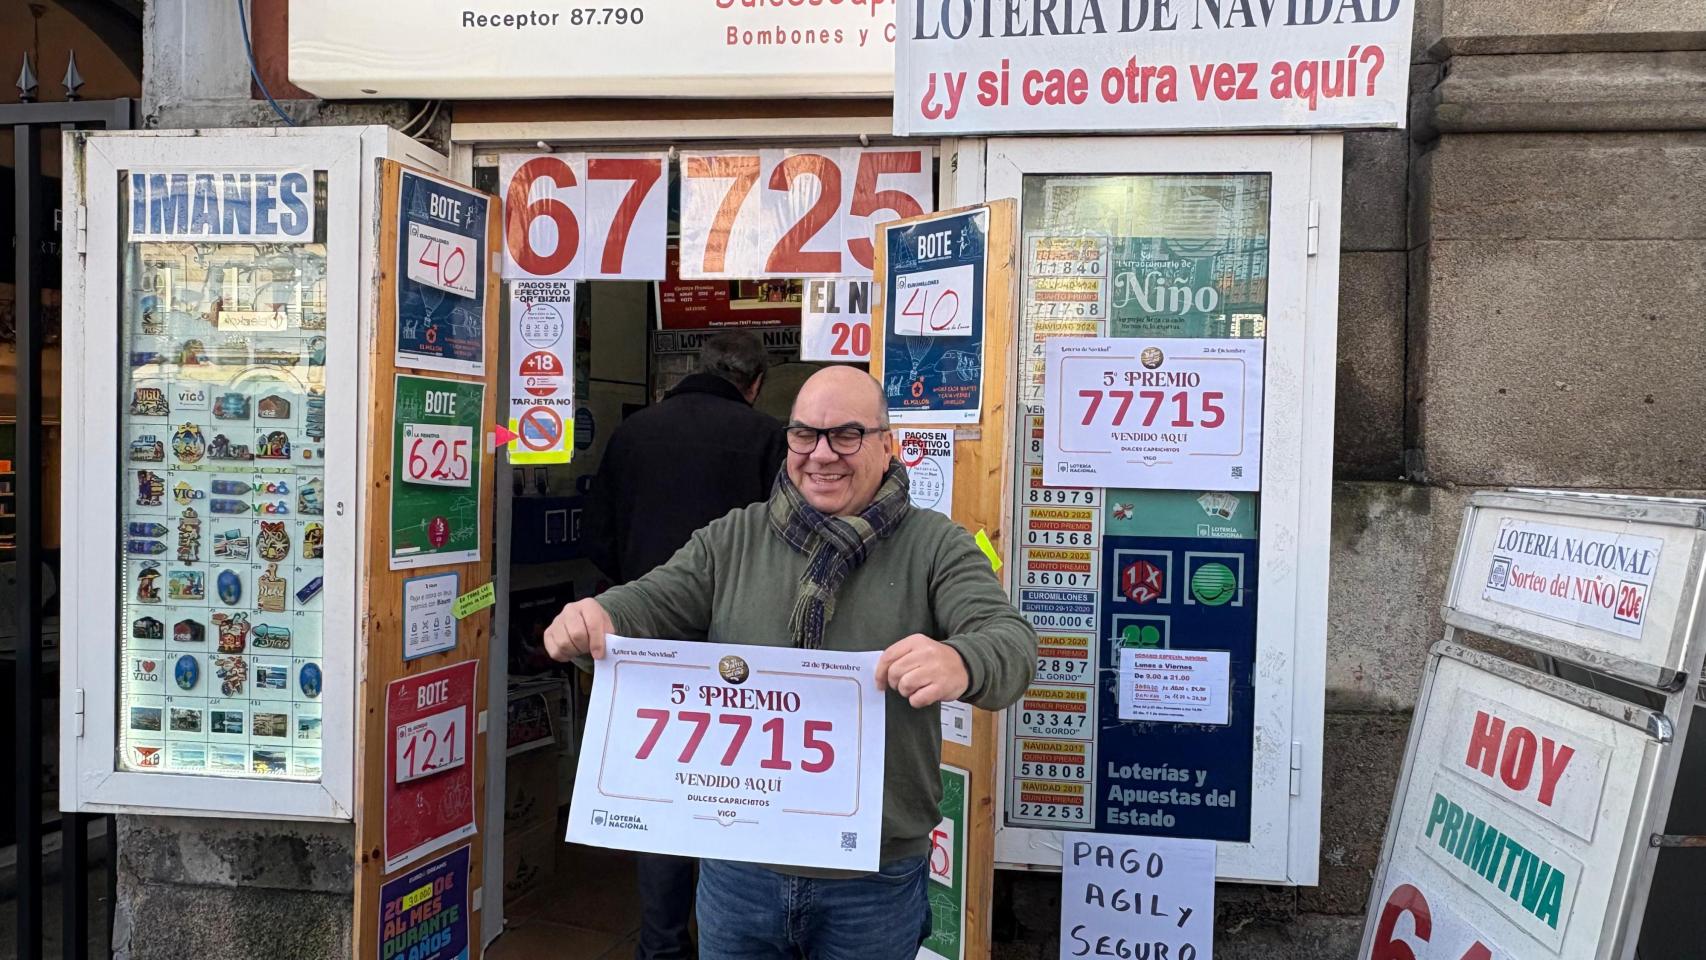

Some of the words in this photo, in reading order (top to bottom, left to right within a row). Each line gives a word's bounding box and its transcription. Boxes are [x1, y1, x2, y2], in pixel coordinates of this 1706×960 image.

[462, 11, 559, 29] Receptor
[570, 8, 645, 26] 87.790
[1108, 0, 1178, 33] DE
[726, 26, 843, 45] Bombones
[859, 28, 868, 47] y
[921, 71, 967, 120] ¿y
[977, 58, 1010, 106] si
[1022, 64, 1088, 106] cae
[1101, 54, 1177, 104] otra
[1190, 62, 1258, 102] vez
[1270, 45, 1385, 111] aquí?
[132, 172, 309, 236] IMANES
[430, 192, 462, 223] BOTE
[918, 230, 952, 260] BOTE
[419, 239, 465, 286] 40
[1036, 262, 1100, 274] 11840
[810, 281, 840, 314] EL
[848, 281, 872, 314] N
[1112, 271, 1218, 316] Niño
[902, 288, 959, 336] 40
[528, 354, 554, 372] +18
[1124, 372, 1200, 387] PREMIO
[425, 390, 456, 414] BOTE
[512, 398, 556, 406] TARJETA
[556, 398, 570, 406] NO
[1078, 390, 1225, 428] 77715
[902, 440, 943, 448] EFECTIVO
[905, 432, 934, 440] PAGOS
[1112, 433, 1158, 442] VENDIDO
[173, 488, 204, 500] VIGO
[1030, 490, 1094, 504] 88979
[1030, 510, 1068, 519] NAVIDAD
[1071, 510, 1091, 519] 2023
[1031, 521, 1058, 530] QUINTO
[1060, 522, 1090, 531] PREMIO
[1028, 531, 1092, 545] 01568
[1030, 550, 1068, 559] NAVIDAD
[1070, 551, 1089, 560] 2023
[1497, 528, 1559, 560] LOTERIA
[1560, 538, 1654, 576] NACIONAL
[1058, 563, 1088, 571] PREMIO
[1027, 572, 1091, 586] 86007
[1508, 567, 1546, 592] Sorteo
[1550, 576, 1570, 598] del
[1572, 574, 1615, 609] NIÑO
[1028, 592, 1088, 601] EUROMILLONES
[1616, 586, 1642, 618] 20€
[1086, 617, 1093, 627] €
[1038, 637, 1065, 645] VIDAD
[1057, 650, 1087, 658] PREMIO
[821, 662, 860, 671] Diciembre
[1038, 659, 1088, 674] 2897
[417, 678, 449, 710] BOTE
[699, 684, 801, 712] PREMIO
[1024, 702, 1054, 710] PRIMER
[1055, 703, 1084, 711] PREMIO
[1023, 712, 1086, 727] 03347
[635, 708, 835, 774] 77715
[1023, 742, 1062, 750] NAVIDAD
[1063, 743, 1083, 751] 2017
[1465, 710, 1576, 808] HOY
[1022, 764, 1085, 778] 58808
[1108, 762, 1189, 782] Loterías
[1195, 770, 1207, 788] y
[675, 772, 740, 789] VENDIDO
[745, 776, 782, 794] AQUÍ
[1022, 782, 1060, 791] NAVIDAD
[1062, 784, 1082, 792] 2017
[687, 794, 718, 803] DULCES
[718, 796, 770, 807] CAPRICHITOS
[1052, 795, 1082, 803] PREMIO
[1108, 784, 1201, 806] Apuestas
[1205, 789, 1236, 807] del
[609, 814, 641, 823] LOTERÍA
[1020, 804, 1084, 819] 22253
[1107, 807, 1175, 827] Estado
[608, 821, 648, 831] NACIONAL
[1073, 841, 1163, 878] PAGO
[1424, 792, 1565, 930] PRIMITIVA
[433, 872, 454, 896] DE
[1085, 883, 1168, 916] AGIL
[384, 916, 406, 942] AL
[411, 896, 442, 928] MES
[384, 904, 459, 960] DURANTE
[1071, 925, 1196, 960] SEGURO
